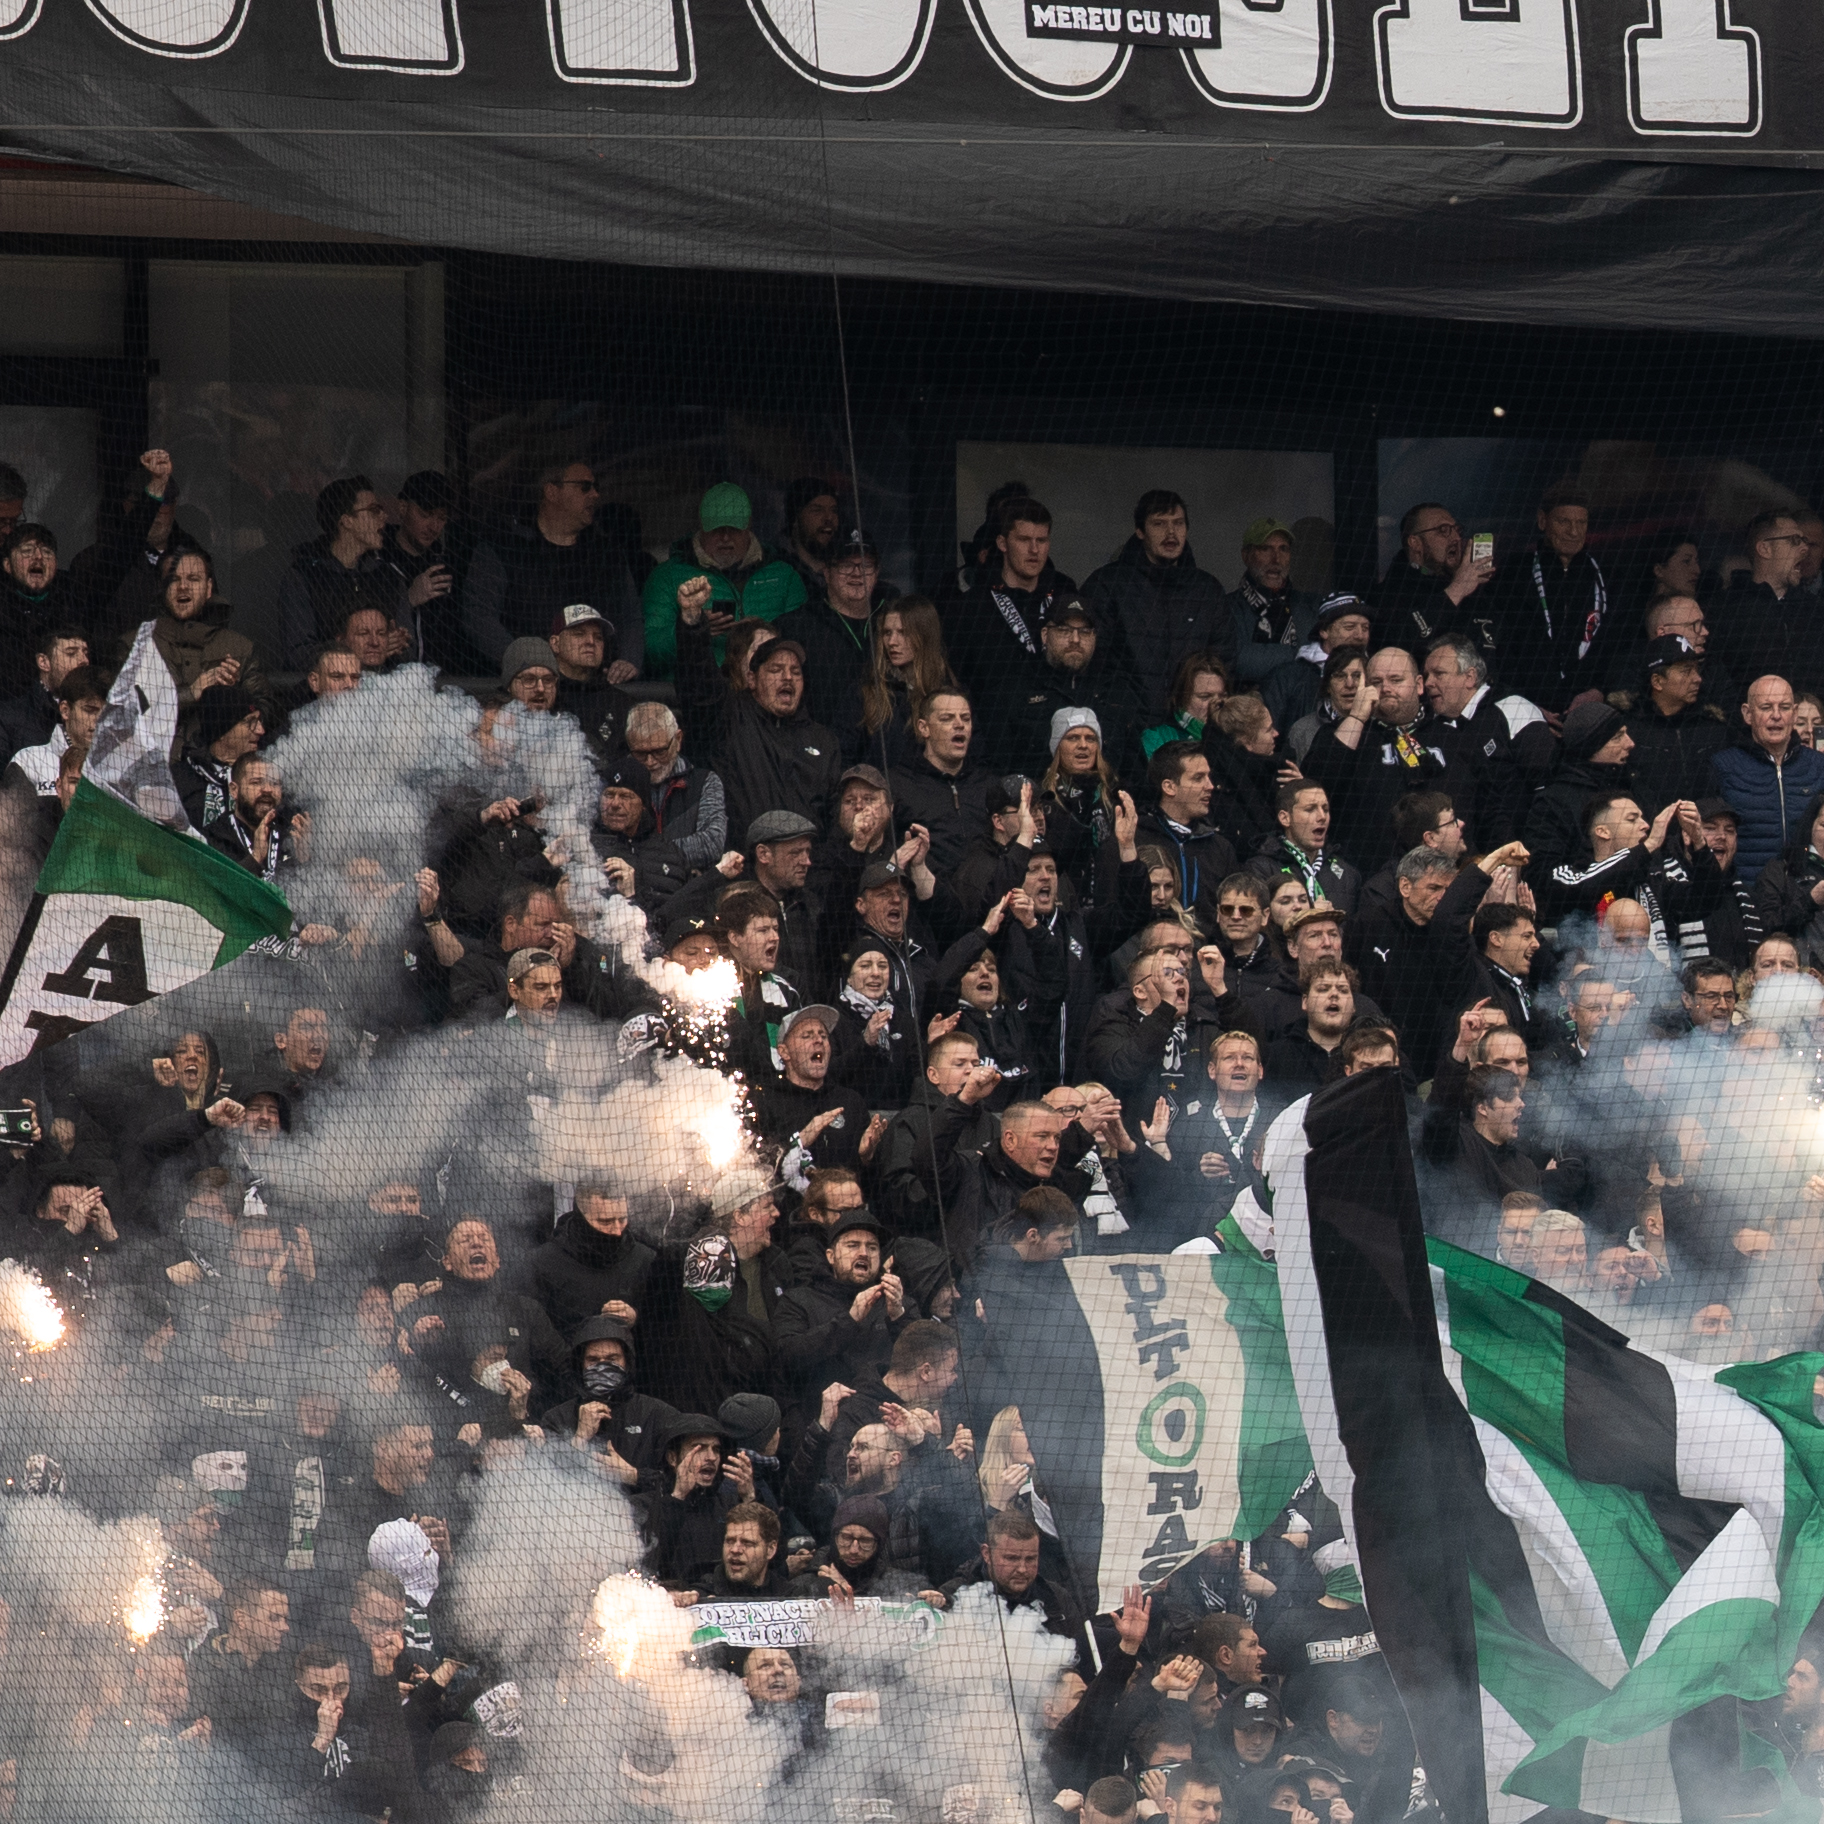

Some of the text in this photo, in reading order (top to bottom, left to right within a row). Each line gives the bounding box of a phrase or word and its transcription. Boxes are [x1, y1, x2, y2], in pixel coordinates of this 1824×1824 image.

[1031, 5, 1213, 39] MEREU CU NOI
